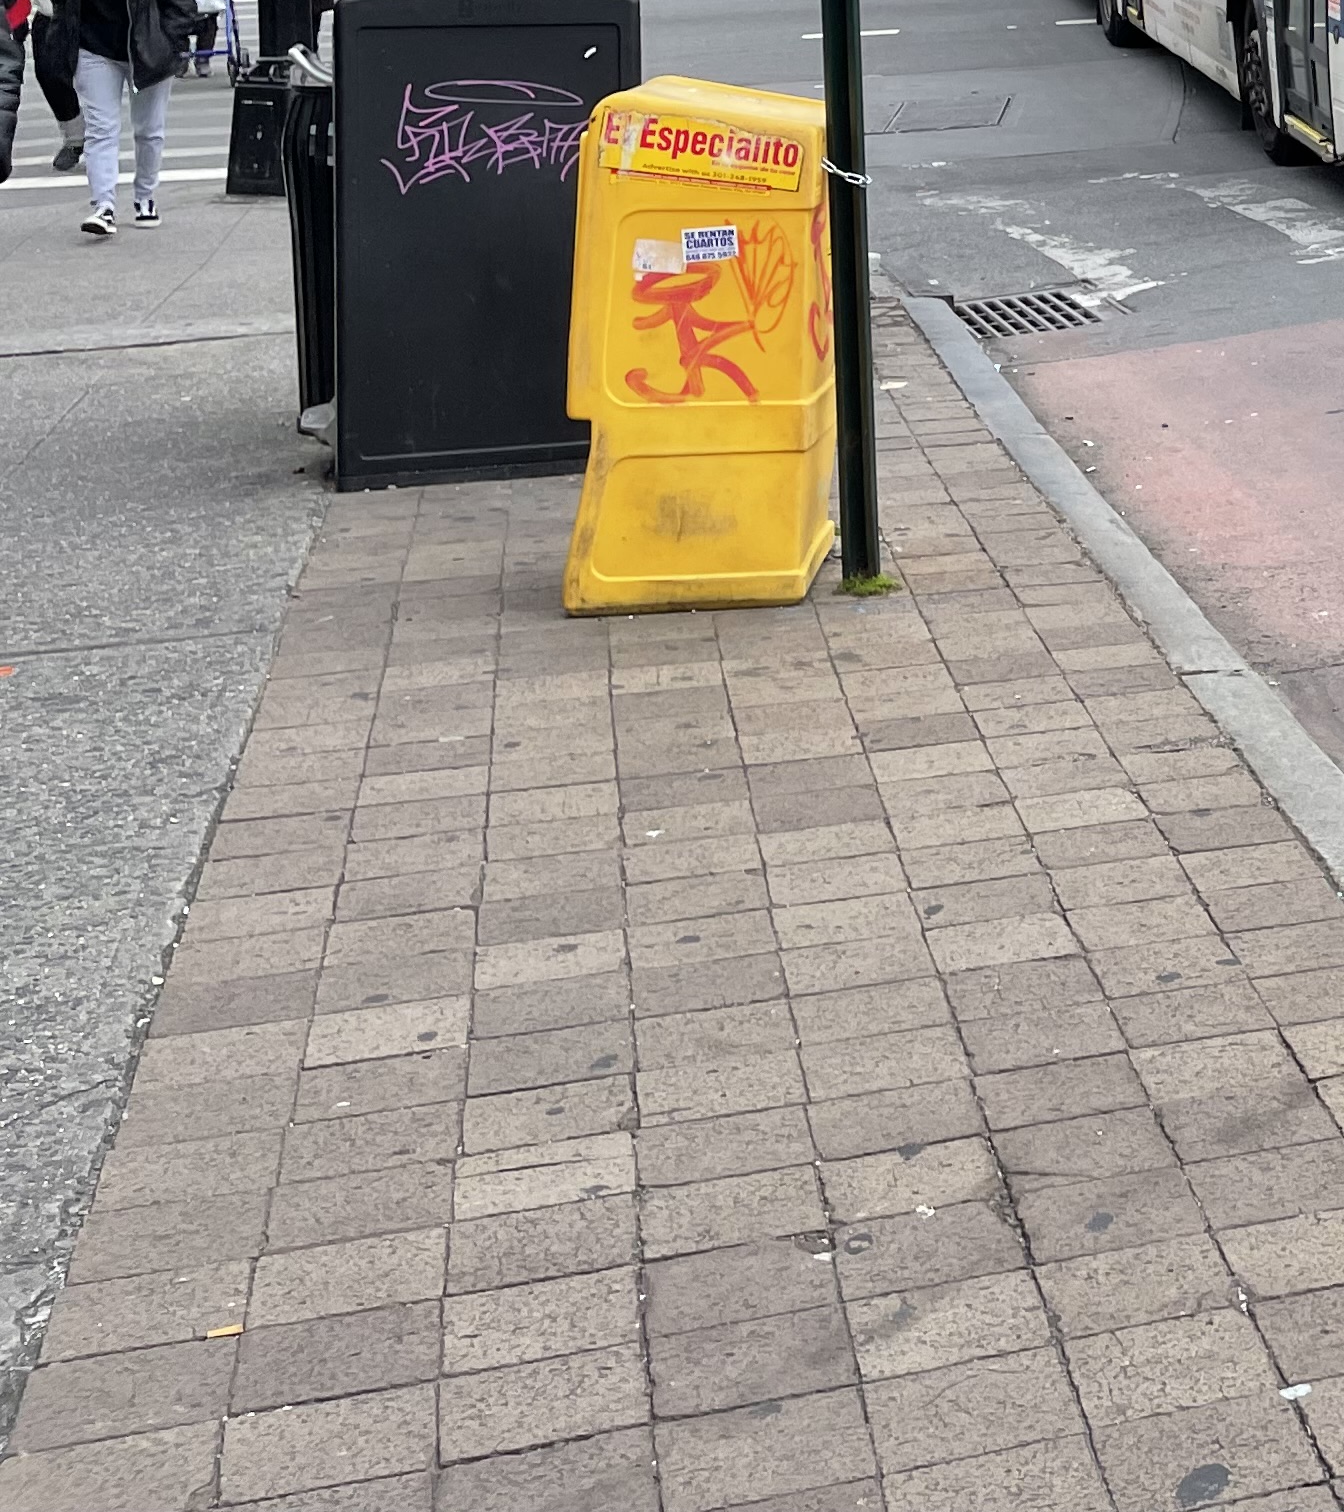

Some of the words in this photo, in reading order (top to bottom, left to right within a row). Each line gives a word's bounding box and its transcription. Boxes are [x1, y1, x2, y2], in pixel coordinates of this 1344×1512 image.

[640, 117, 799, 168] Especialito
[642, 163, 681, 173] Advertise
[681, 168, 700, 176] with
[698, 229, 735, 239] RENTAN
[686, 237, 734, 249] CUARTOS
